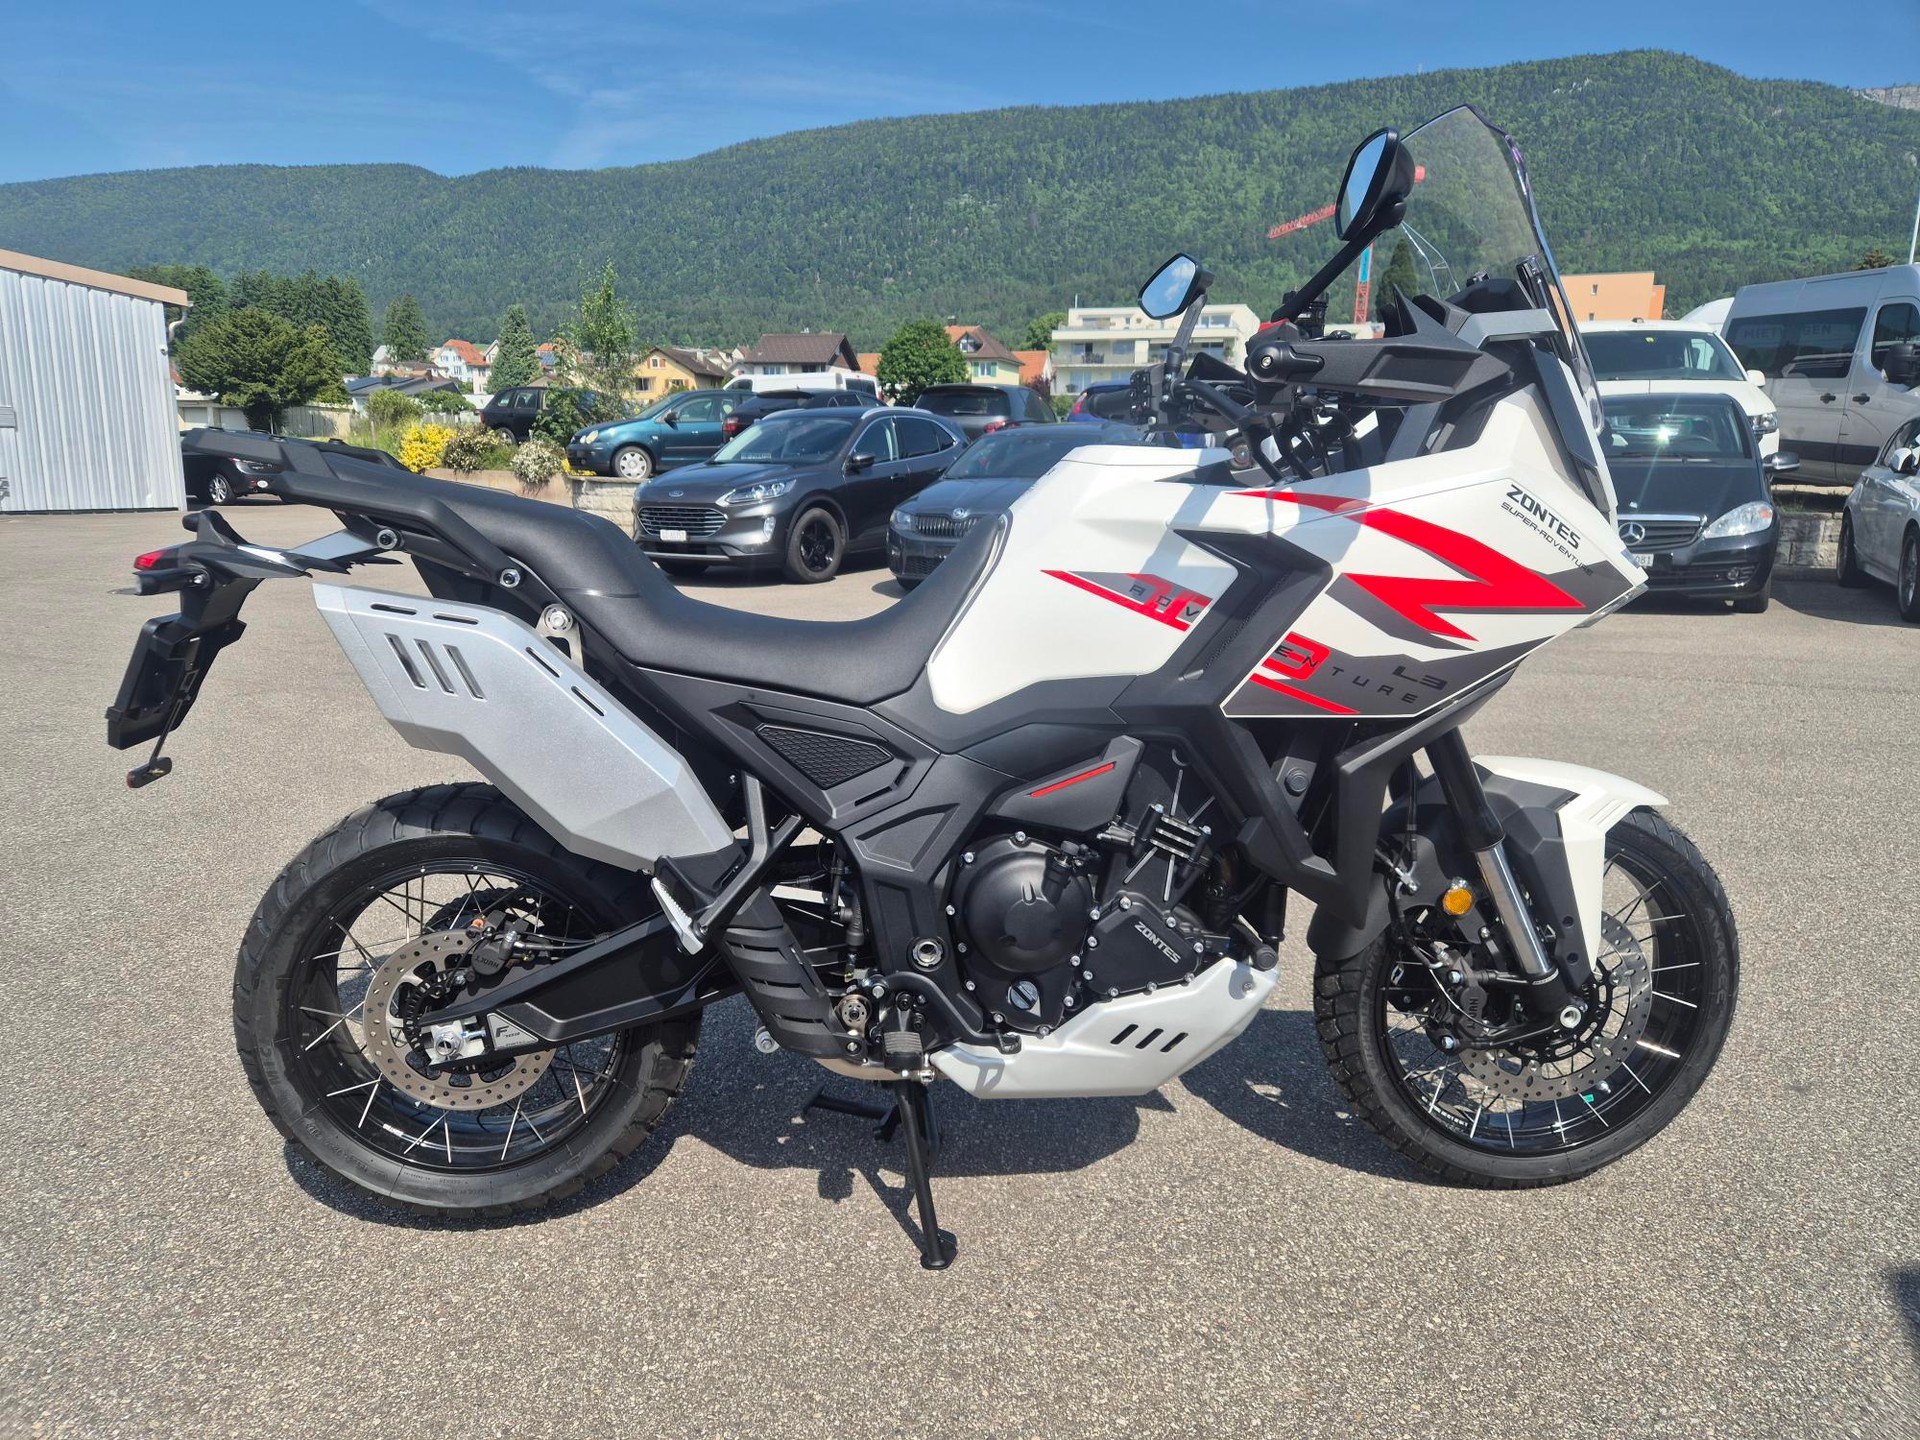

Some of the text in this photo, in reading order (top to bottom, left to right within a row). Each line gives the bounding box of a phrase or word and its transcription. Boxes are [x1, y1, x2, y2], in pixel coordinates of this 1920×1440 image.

[1501, 501, 1594, 577] SUPER-ADVENTURE
[1506, 484, 1581, 549] ZONTES
[1392, 665, 1448, 691] L3
[1134, 921, 1181, 963] ZONTES
